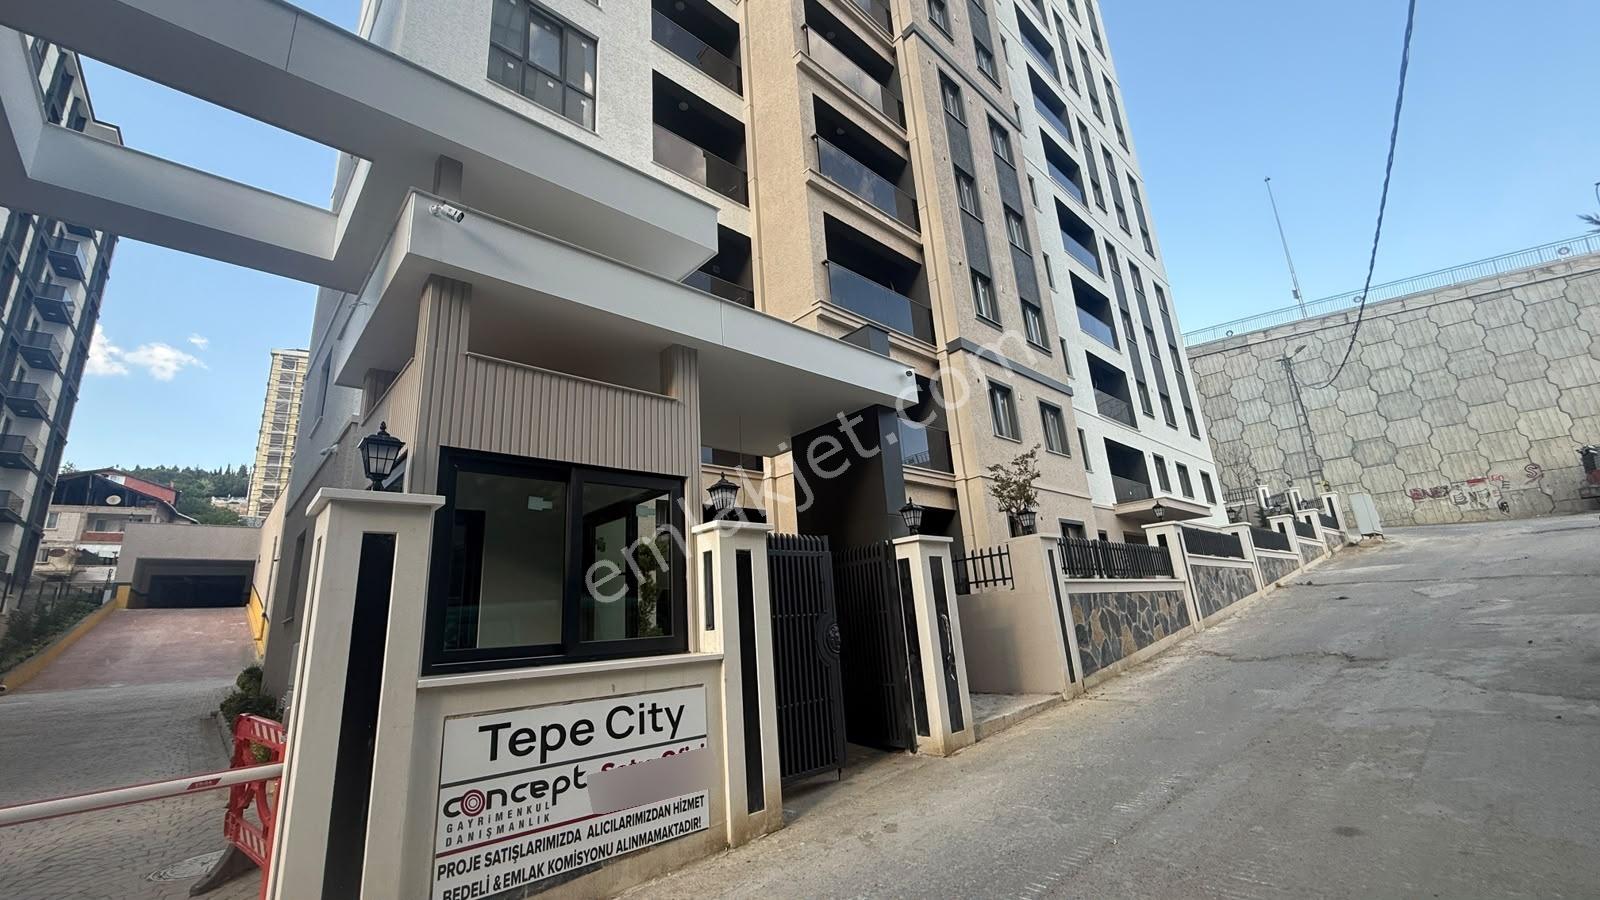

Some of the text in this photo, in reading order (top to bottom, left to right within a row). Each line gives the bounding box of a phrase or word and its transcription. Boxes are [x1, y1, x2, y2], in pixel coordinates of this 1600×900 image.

[478, 719, 595, 764] Tepe
[605, 703, 685, 740] City
[443, 765, 588, 818] concept
[437, 795, 705, 881] PROJE SATIŞLARIMIZDA ALICILARIMIZDAN HİZMET
[442, 816, 702, 900] BEDELİ & EMLAK KOMİSYONU ALINMAMAKTADIR!
[445, 814, 550, 847] DANIŞMANLIK
